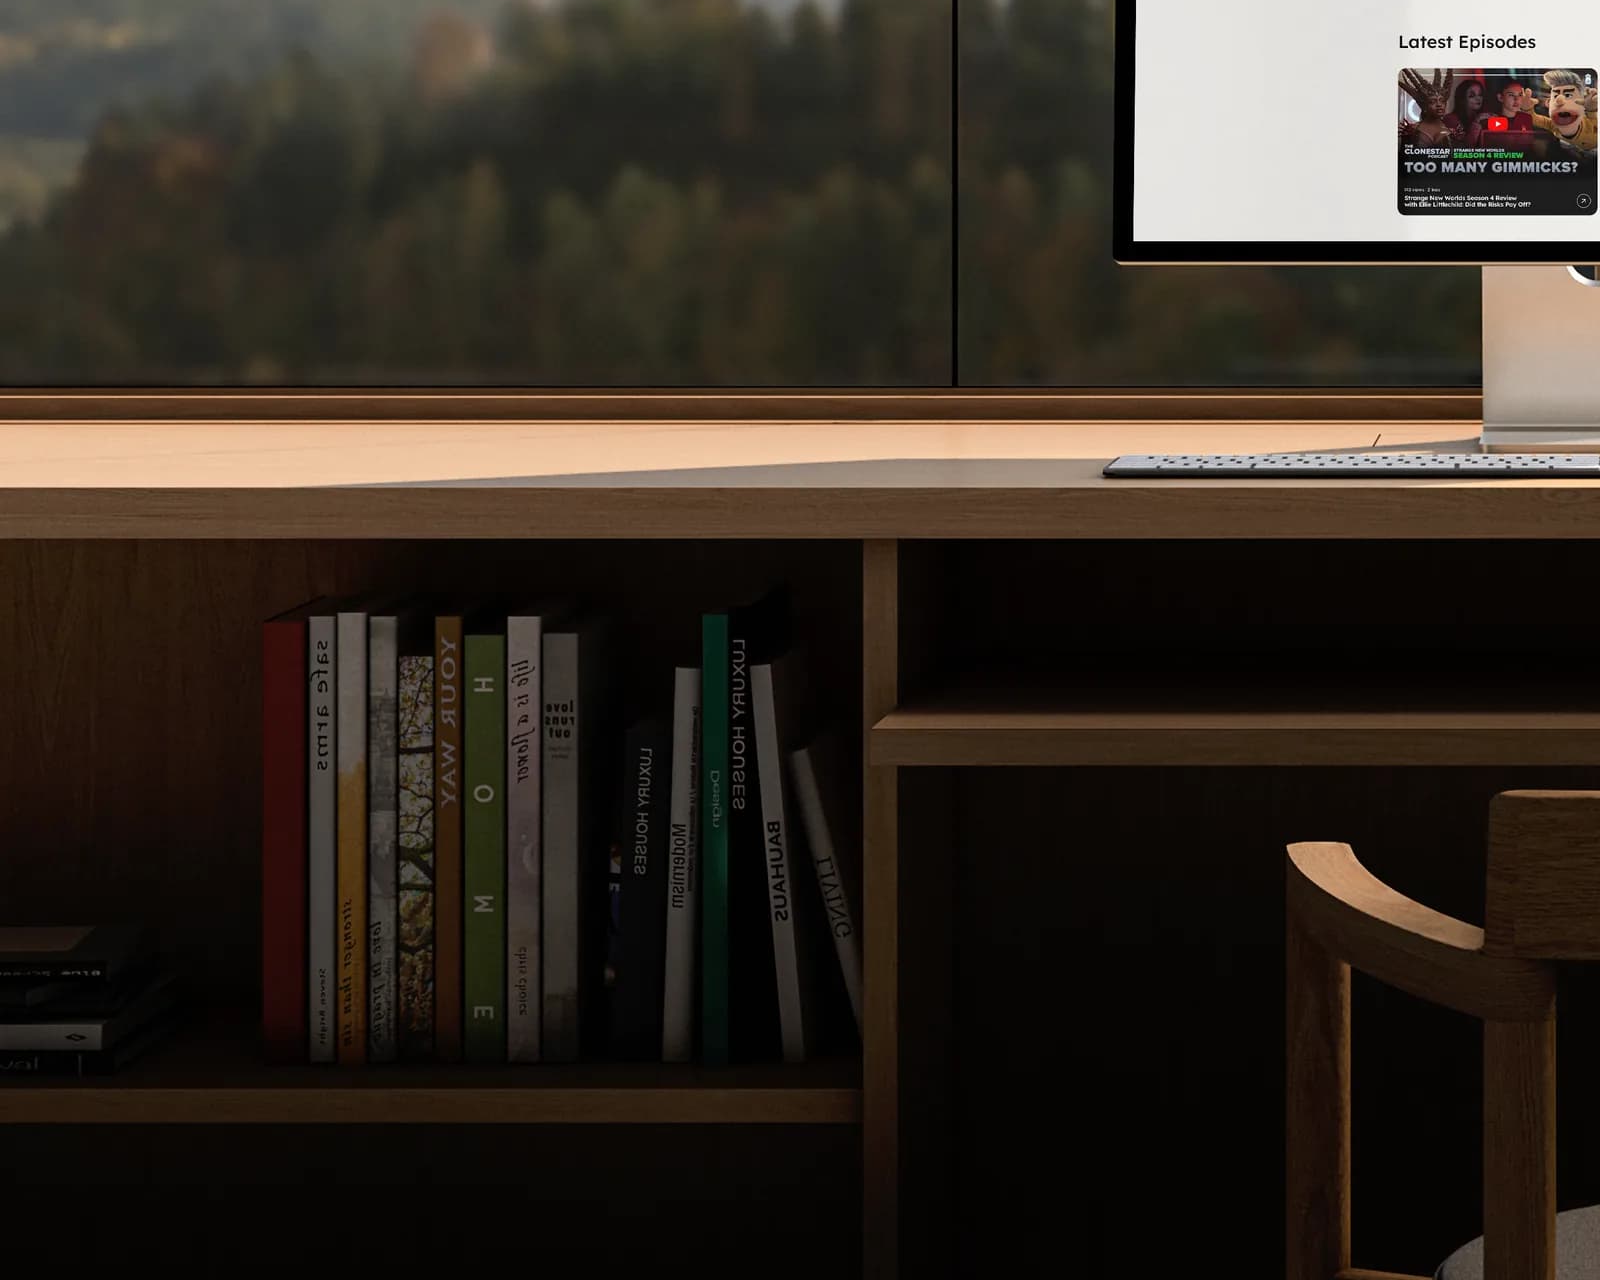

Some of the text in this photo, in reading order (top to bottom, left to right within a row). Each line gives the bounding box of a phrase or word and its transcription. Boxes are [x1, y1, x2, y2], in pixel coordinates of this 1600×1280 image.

[1399, 34, 1537, 54] Latest Episodes
[1404, 162, 1578, 173] TOO MANY GIMMICKS?
